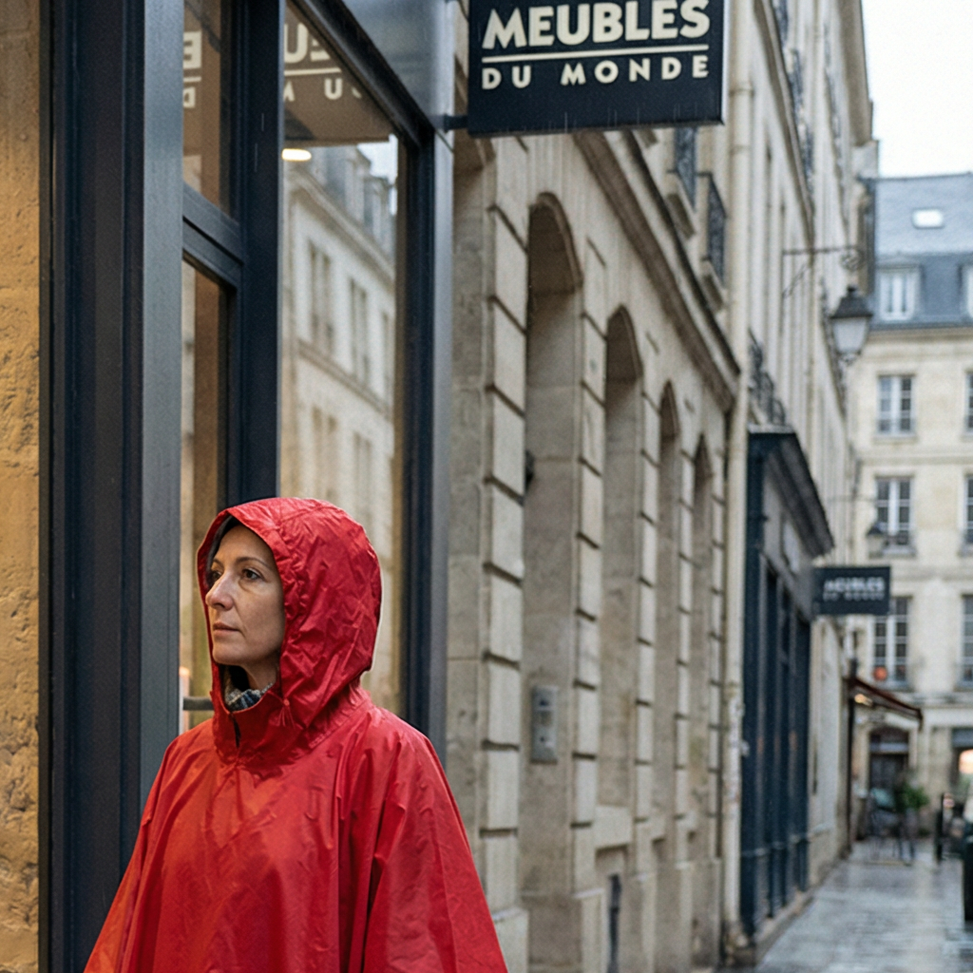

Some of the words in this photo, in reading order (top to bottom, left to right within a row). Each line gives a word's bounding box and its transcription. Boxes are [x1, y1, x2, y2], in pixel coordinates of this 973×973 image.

[482, 0, 710, 49] MEUBLES
[482, 66, 531, 90] DU
[560, 54, 709, 86] MONDE
